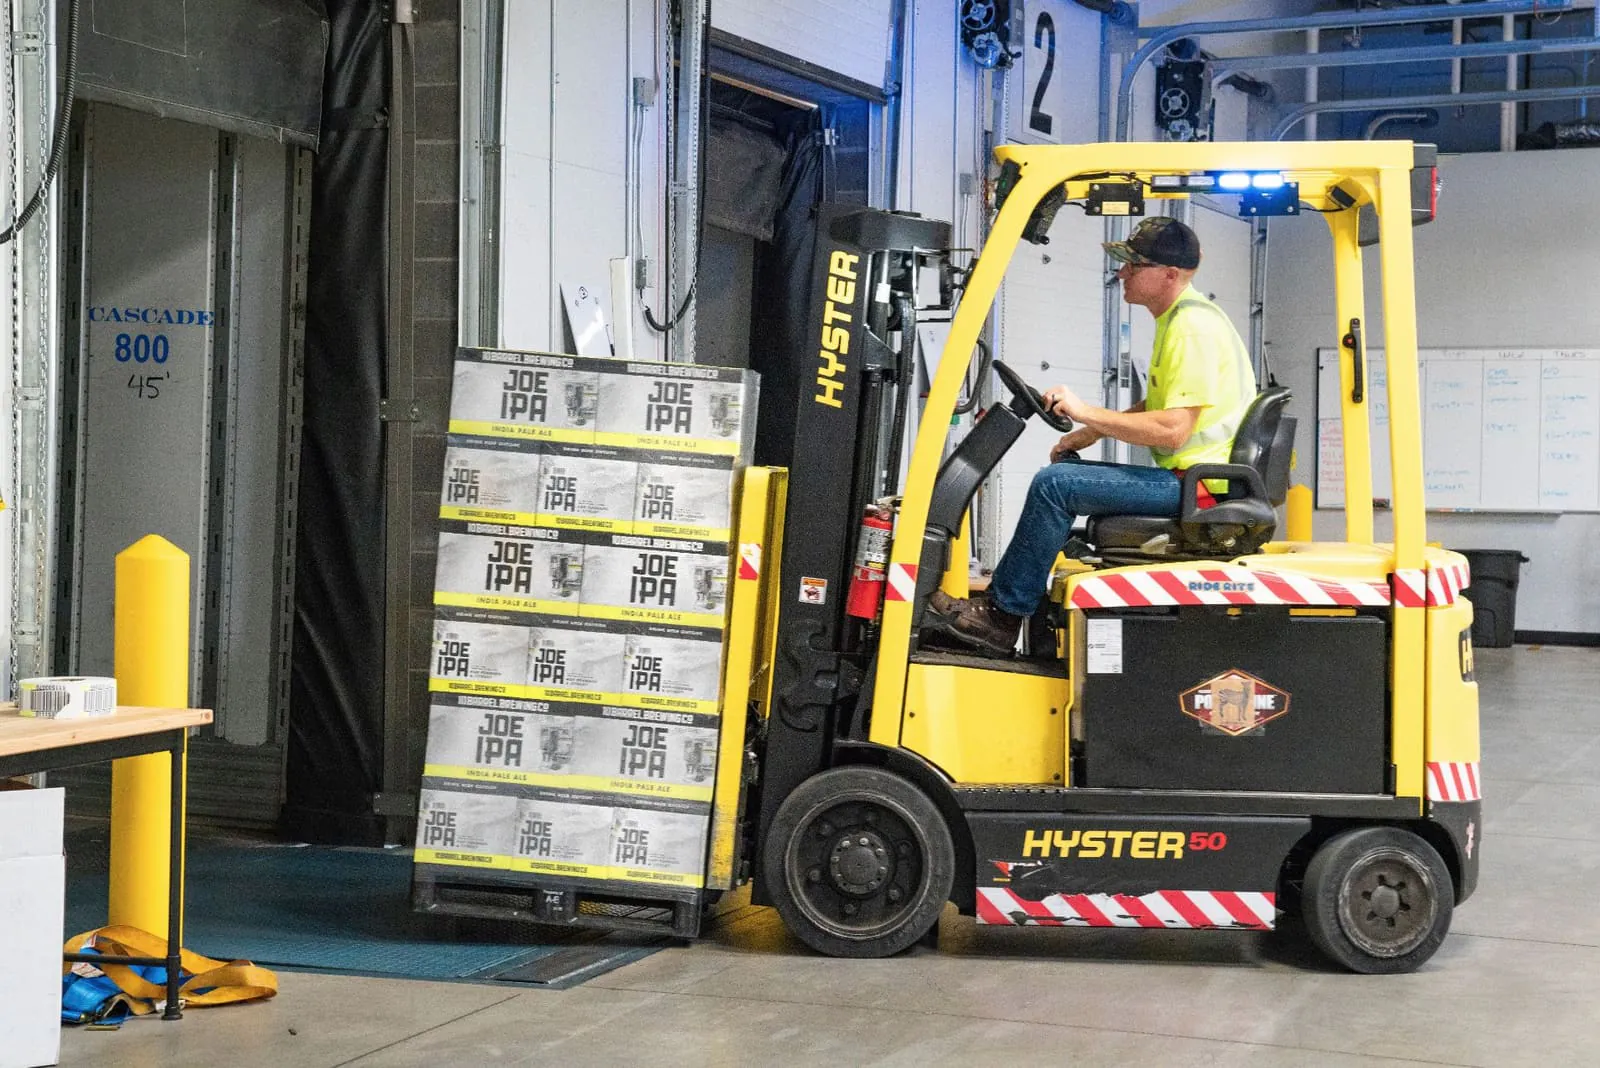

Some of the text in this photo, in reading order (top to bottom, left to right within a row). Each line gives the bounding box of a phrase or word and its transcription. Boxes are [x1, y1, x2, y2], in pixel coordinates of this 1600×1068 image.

[1029, 11, 1056, 136] 2
[88, 306, 216, 326] CASCADE
[815, 250, 859, 409] HYSTER
[115, 333, 169, 364] 800
[503, 369, 549, 394] JOE
[648, 381, 694, 405] JOE
[500, 392, 547, 422] IPA
[645, 404, 692, 434] IPA
[449, 467, 481, 484] JOE
[546, 475, 577, 492] JOE
[447, 483, 479, 504] IPA
[544, 491, 576, 512] IPA
[643, 483, 675, 501] JOE
[641, 499, 673, 520] IPA
[488, 540, 534, 565] JOE
[632, 553, 678, 578] JOE
[485, 563, 532, 594] IPA
[1188, 581, 1256, 592] RIDE RITE
[630, 576, 677, 606] IPA
[439, 640, 471, 658] JOE
[535, 648, 567, 665] JOE
[437, 656, 469, 677] IPA
[533, 663, 565, 684] IPA
[631, 655, 663, 672] JOE
[629, 671, 661, 692] IPA
[478, 713, 525, 738] JOE
[622, 724, 668, 750] JOE
[475, 736, 523, 767] IPA
[620, 747, 666, 778] IPA
[425, 810, 457, 827] JOE
[521, 820, 553, 837] JOE
[423, 826, 456, 847] IPA
[519, 836, 552, 857] IPA
[617, 828, 649, 845] JOE
[1022, 829, 1228, 859] HYSTER 50
[615, 844, 648, 865] IPA
